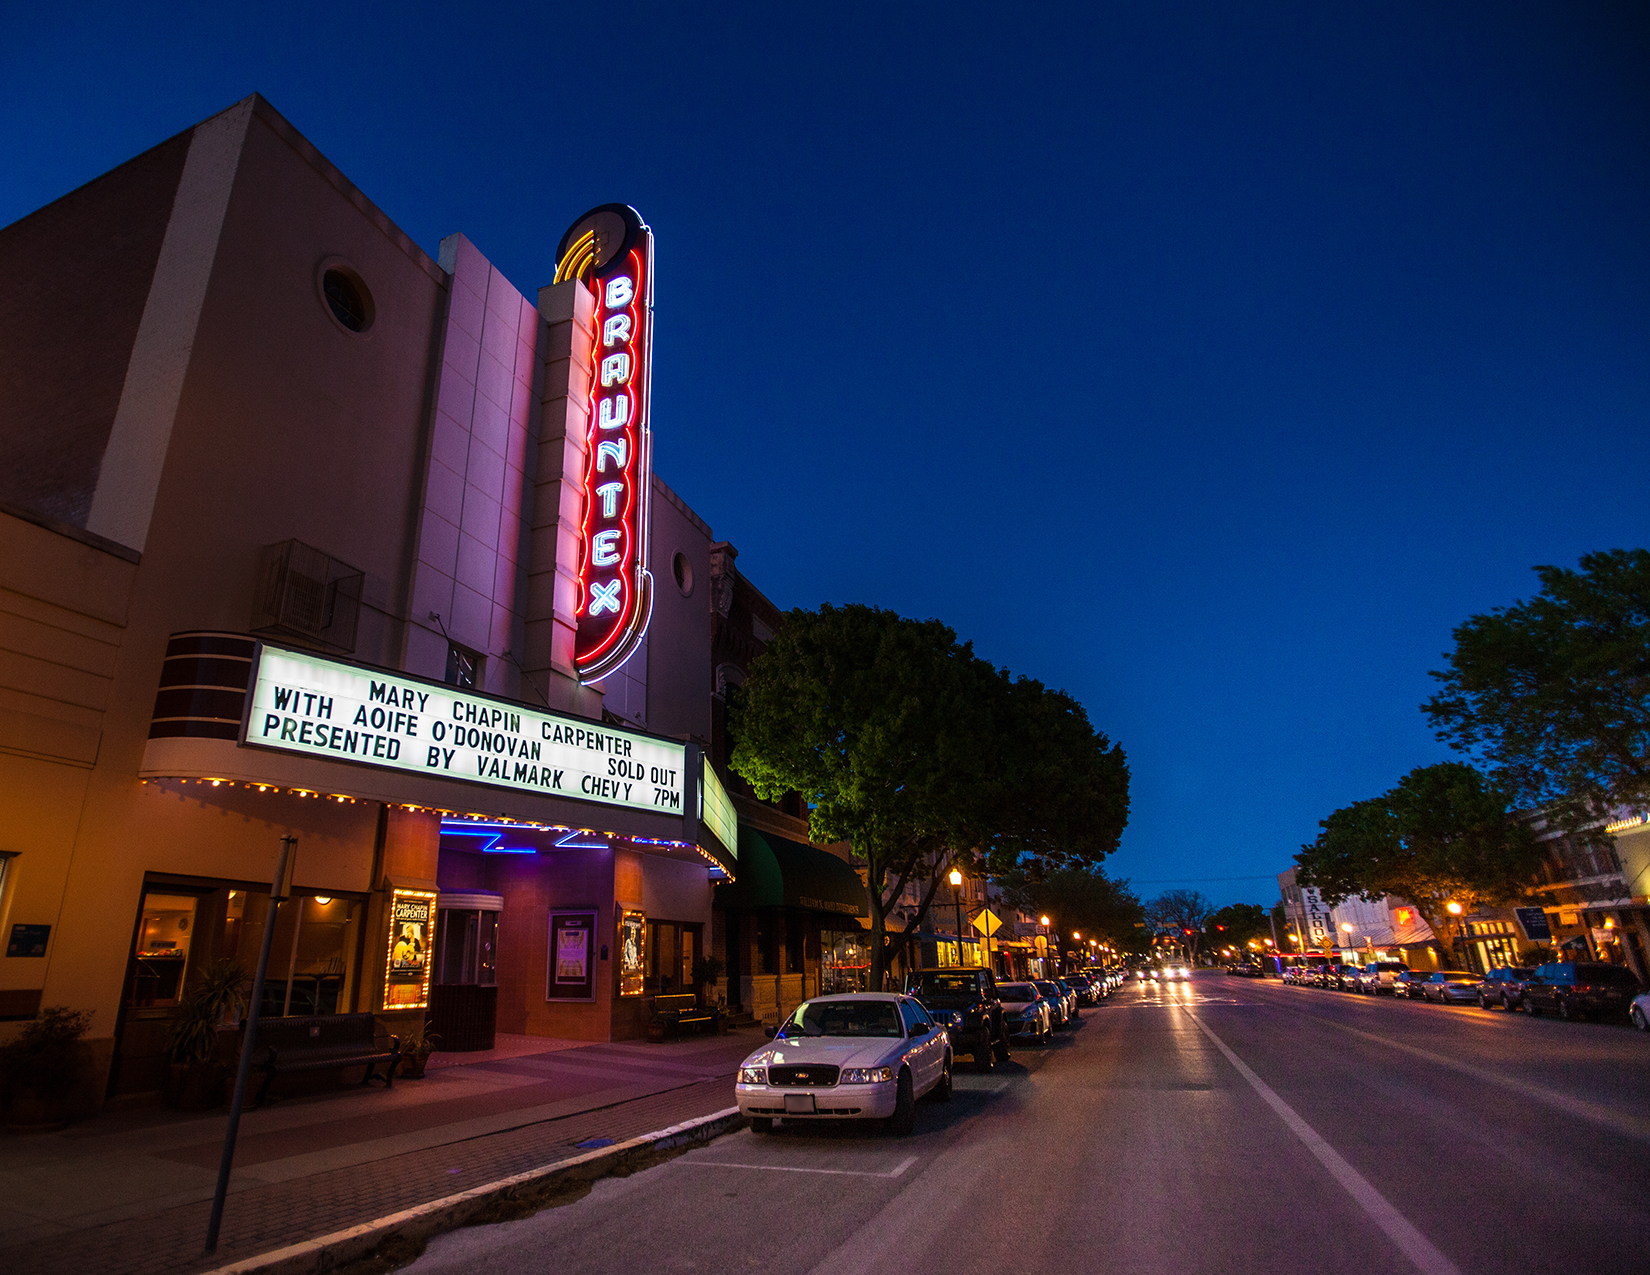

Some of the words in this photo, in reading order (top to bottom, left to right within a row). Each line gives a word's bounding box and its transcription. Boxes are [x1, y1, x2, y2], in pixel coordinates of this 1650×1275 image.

[589, 276, 633, 615] BRAUNTEX
[262, 713, 401, 760] PRESENTED
[426, 746, 455, 769] BY
[478, 755, 564, 789] VALMARK
[581, 775, 633, 801] CHEVY
[654, 788, 680, 809] 7PM
[274, 686, 333, 719] WITH
[353, 705, 418, 736] AOIFE
[432, 720, 541, 761] O'DONOVAN
[608, 758, 645, 780] SOLD
[651, 767, 676, 787] OUT
[369, 680, 429, 712] MARY
[453, 701, 520, 733] CHAPIN
[542, 721, 632, 757] CARPENTER
[395, 909, 427, 918] CARPENTER
